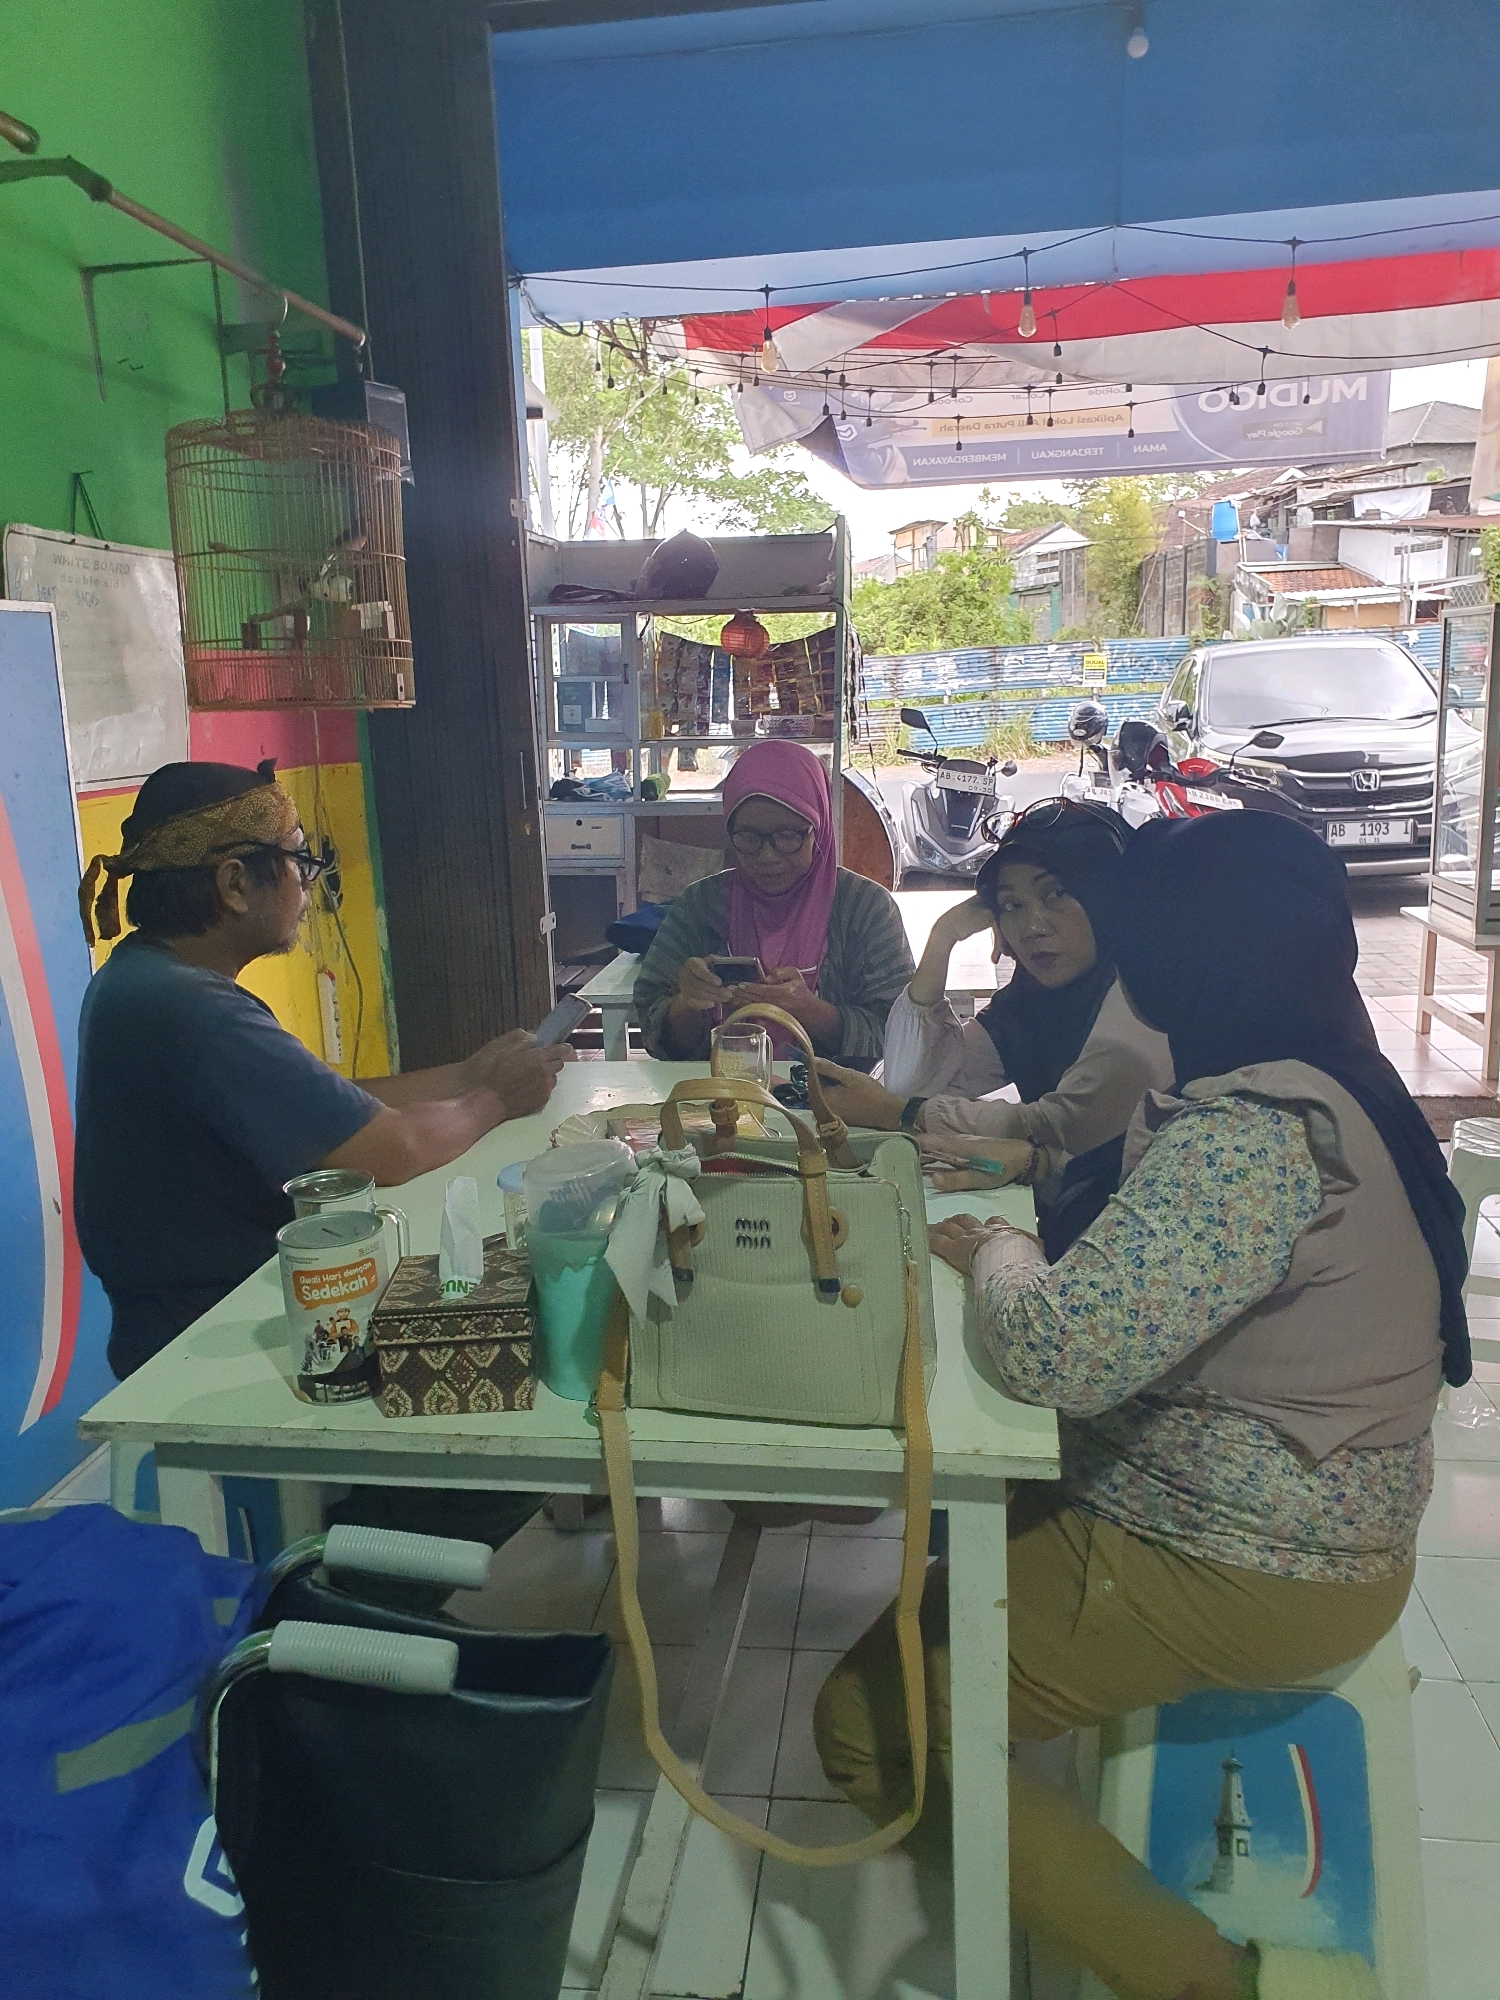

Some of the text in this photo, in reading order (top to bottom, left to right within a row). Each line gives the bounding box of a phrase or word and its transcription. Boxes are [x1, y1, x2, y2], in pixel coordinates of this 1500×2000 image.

[52, 553, 131, 575] WHITE BOARD
[940, 771, 951, 780] AB
[982, 777, 994, 786] SP
[1330, 821, 1410, 838] AB 1193 I
[322, 1271, 341, 1282] Hari
[343, 1261, 373, 1278] dengan
[301, 1274, 369, 1301] Sedekah
